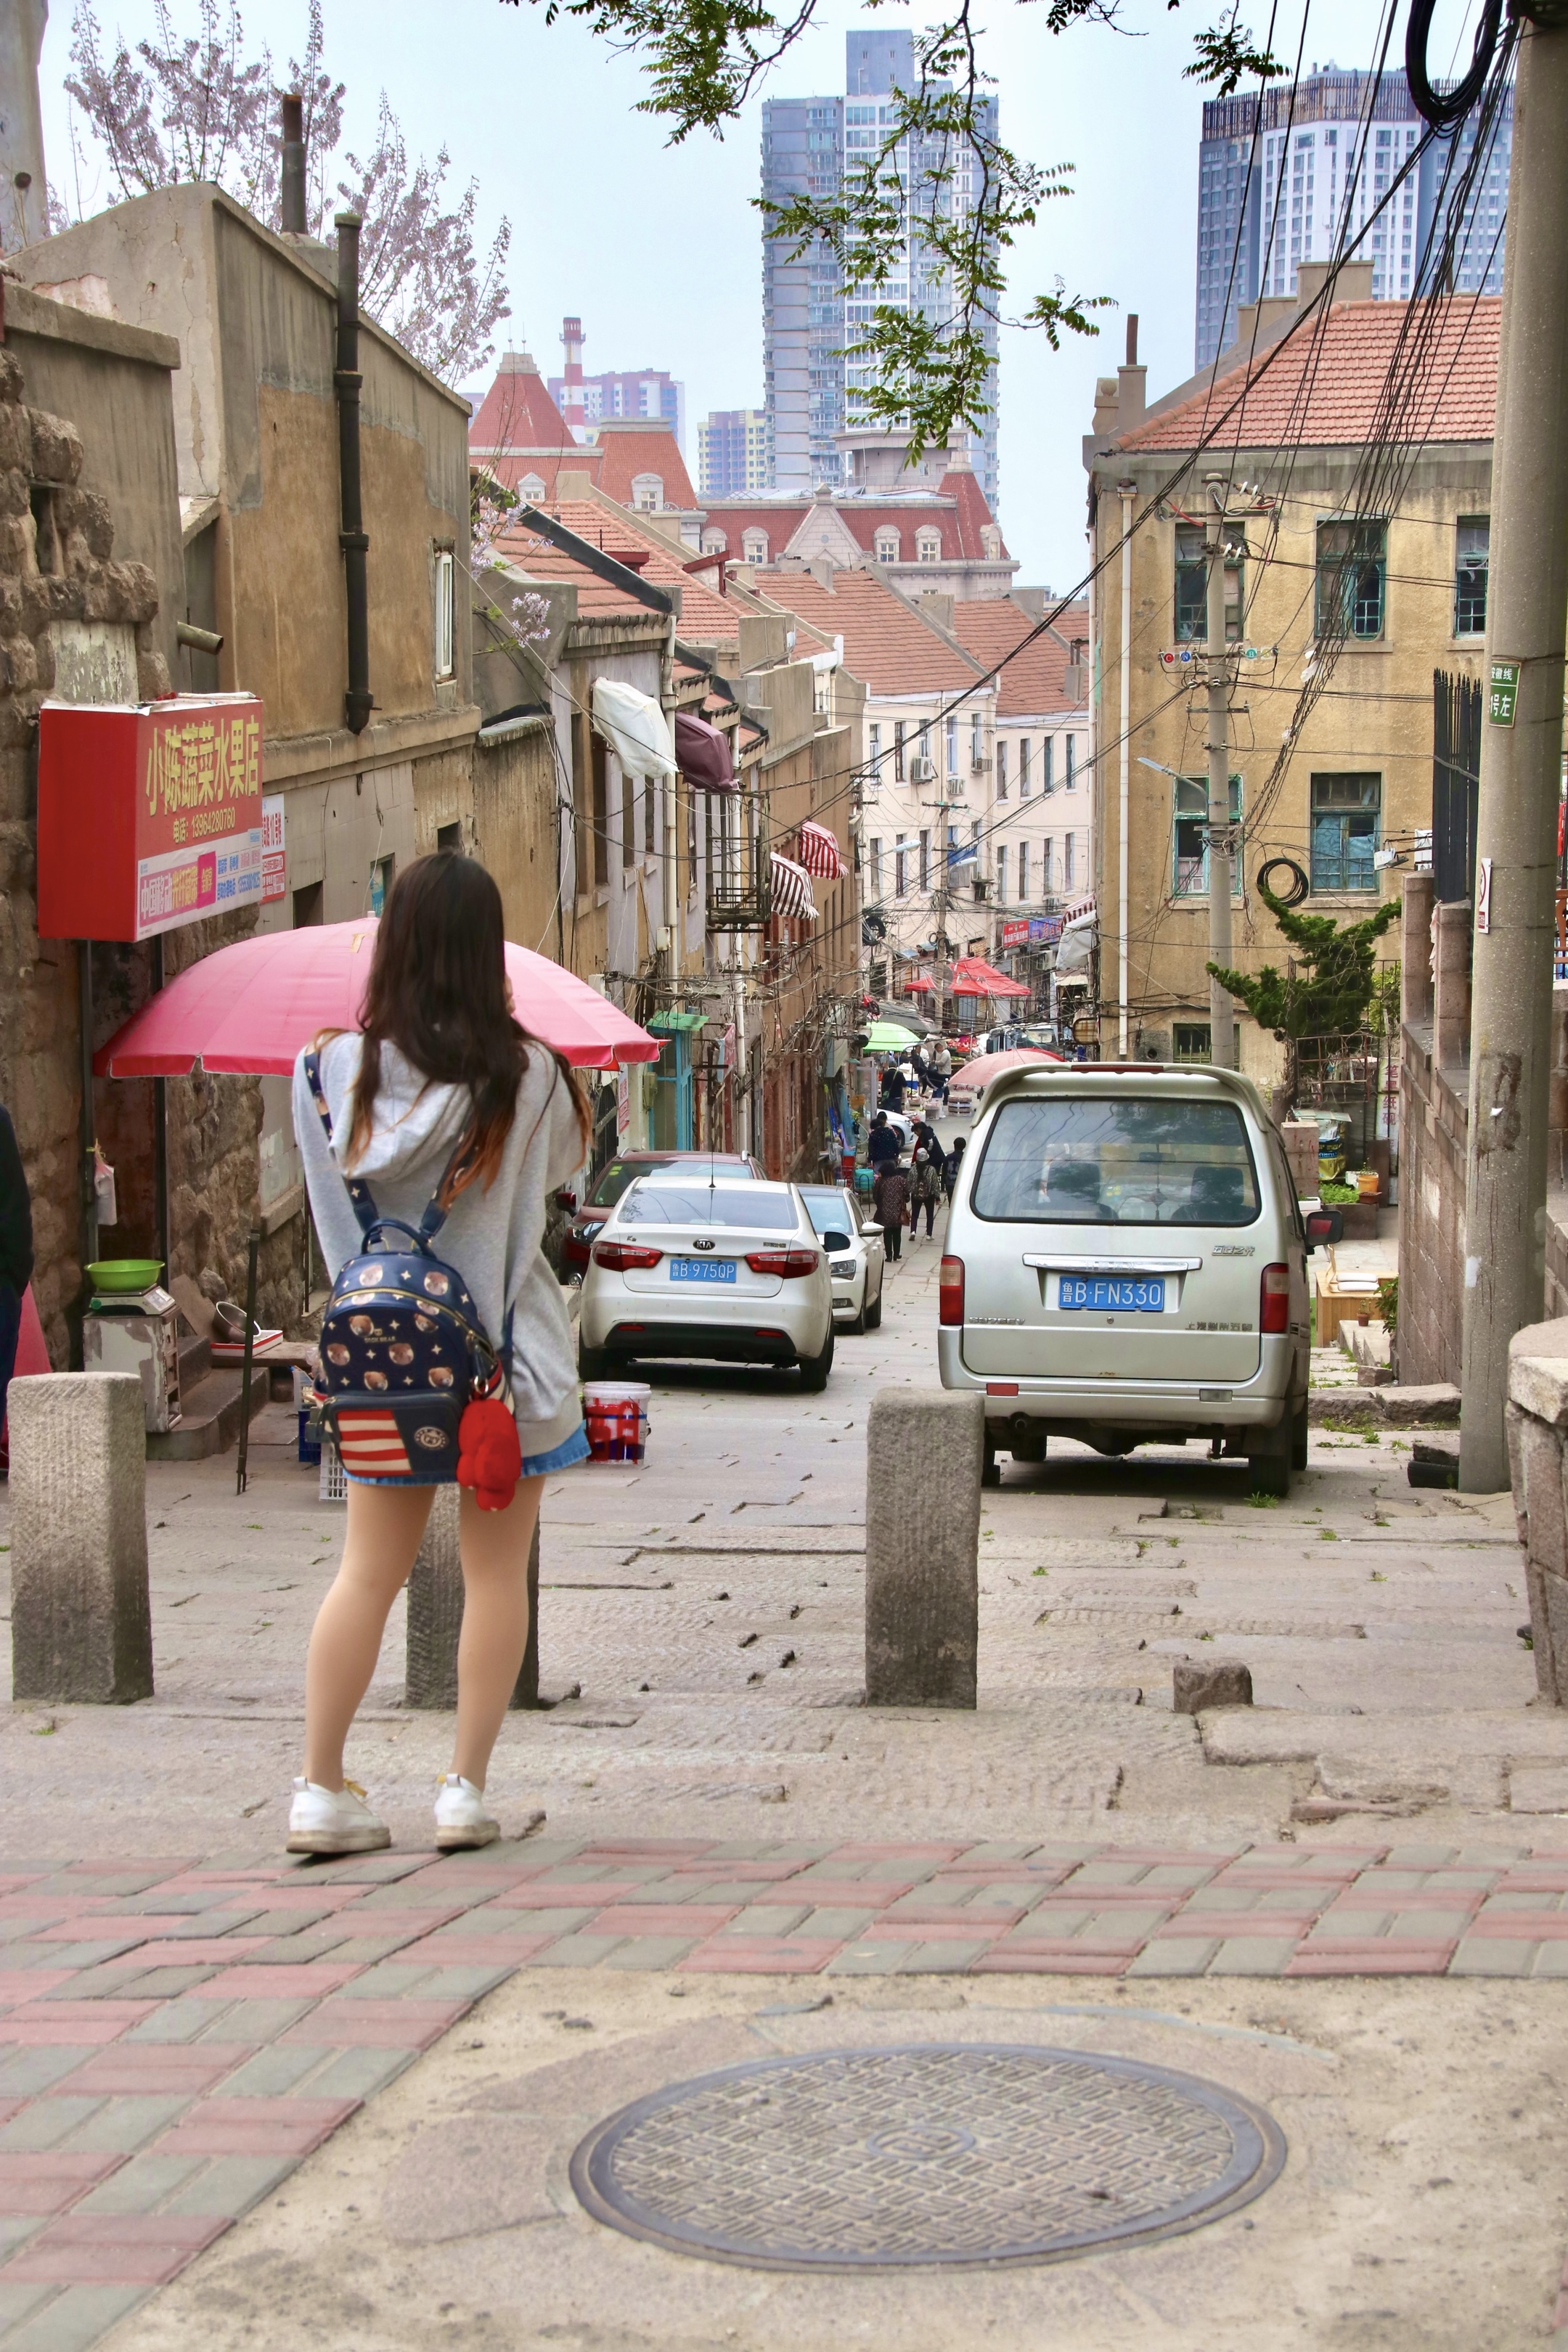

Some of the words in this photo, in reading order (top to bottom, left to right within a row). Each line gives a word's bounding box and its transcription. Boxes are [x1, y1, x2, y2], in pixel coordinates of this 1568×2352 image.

[1182, 650, 1189, 659] N
[1249, 649, 1255, 658] B
[146, 714, 259, 817] 小陈蔬菜水果店
[192, 807, 235, 838] 13964280760
[672, 1263, 735, 1279] 鲁B·975QP
[1062, 1282, 1161, 1305] 鲁B·FN330
